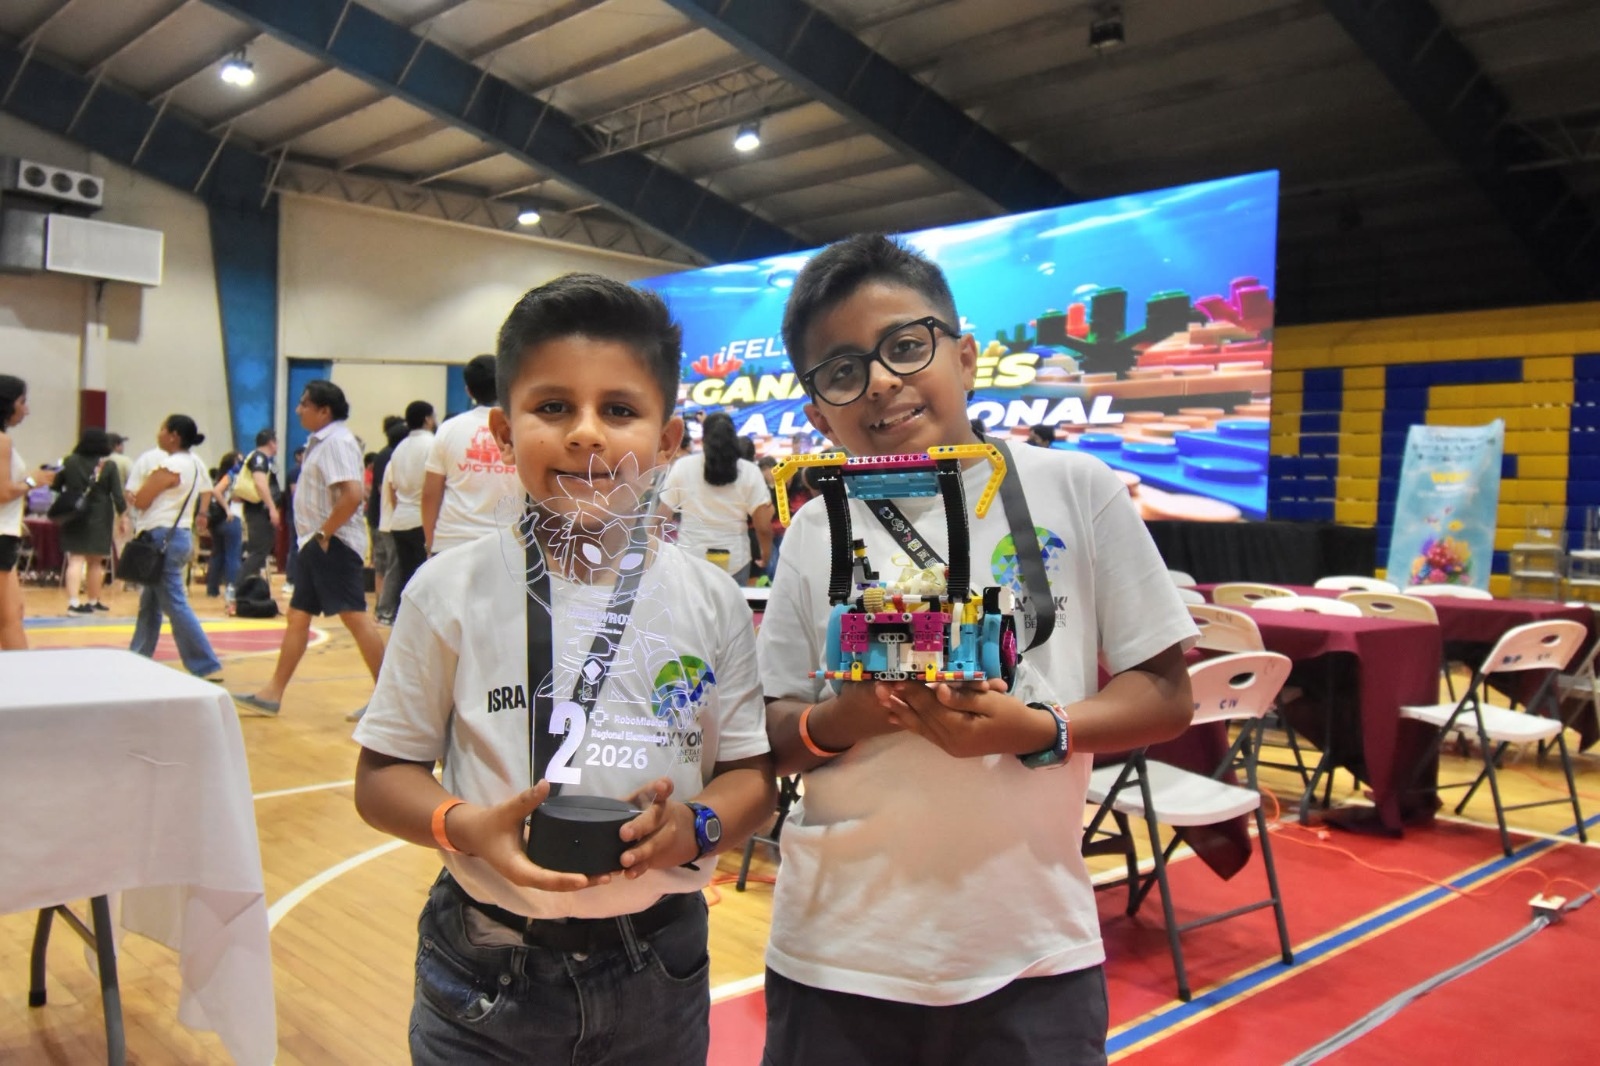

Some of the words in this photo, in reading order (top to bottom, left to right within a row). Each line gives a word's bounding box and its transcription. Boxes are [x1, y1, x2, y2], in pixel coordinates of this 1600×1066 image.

[487, 684, 527, 713] ISRA
[591, 728, 624, 741] Regional
[614, 714, 668, 728] RoboMission
[544, 701, 587, 785] 2
[585, 743, 648, 770] 2026
